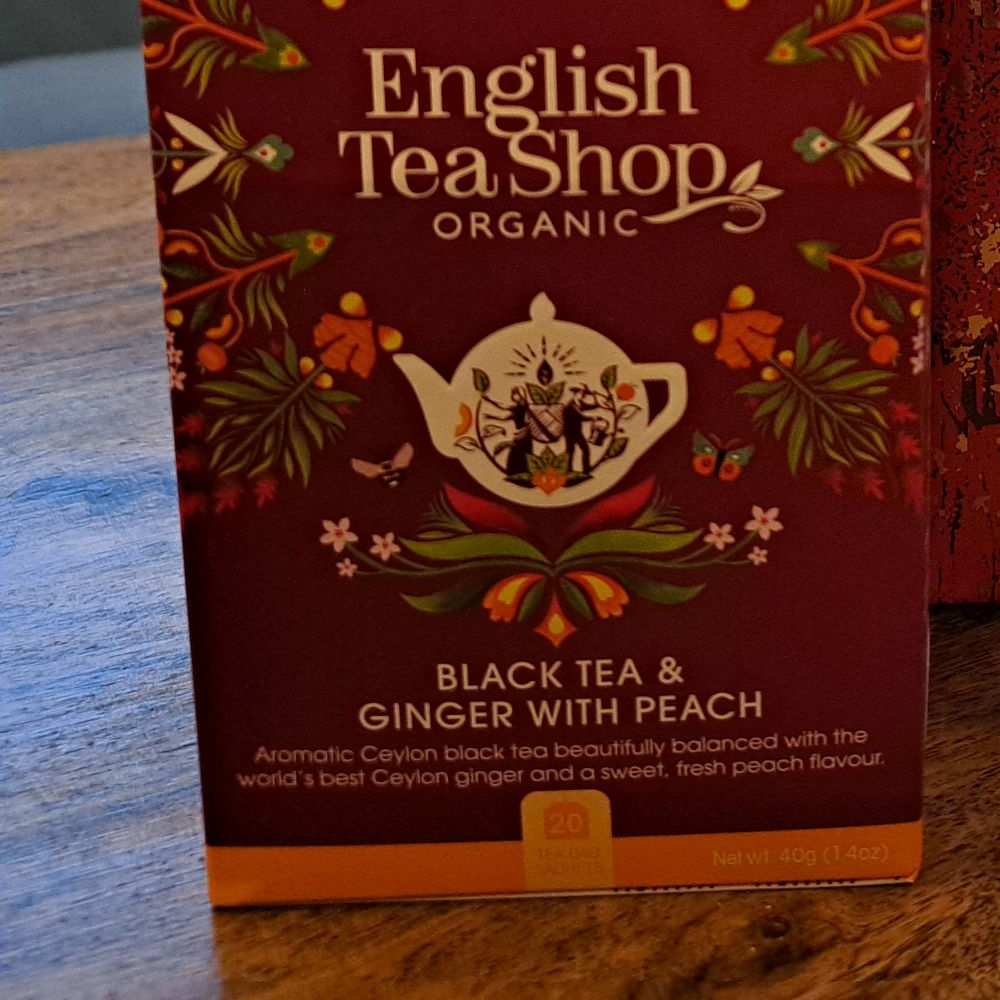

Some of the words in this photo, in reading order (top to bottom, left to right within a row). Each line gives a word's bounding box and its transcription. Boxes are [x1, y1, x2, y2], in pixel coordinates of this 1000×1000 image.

[363, 44, 699, 138] English
[338, 130, 499, 199] Tea
[508, 129, 768, 234] Shop
[433, 208, 639, 240] ORGANIC
[436, 660, 563, 691] BLACK
[576, 658, 643, 687] TEA
[657, 655, 685, 685] &
[358, 701, 513, 731] GINGER
[526, 698, 619, 727] WITH
[635, 691, 763, 724] PEACH
[254, 745, 354, 764] Aromatic
[360, 744, 438, 767] Ceylon
[444, 743, 504, 762] black
[511, 743, 548, 759] tea
[554, 738, 665, 758] beautifully
[671, 733, 778, 754] balanced
[784, 731, 828, 748] with
[833, 727, 869, 745] the
[237, 770, 314, 788] world's
[319, 769, 365, 787] best
[371, 767, 449, 789] Ceylon
[455, 766, 524, 788] ginger
[530, 765, 574, 782] and
[580, 766, 595, 781] a
[676, 759, 726, 777] fresh
[732, 755, 803, 778] peach
[810, 752, 885, 770] flavour.
[548, 812, 584, 834] 20
[779, 846, 817, 866] 40g
